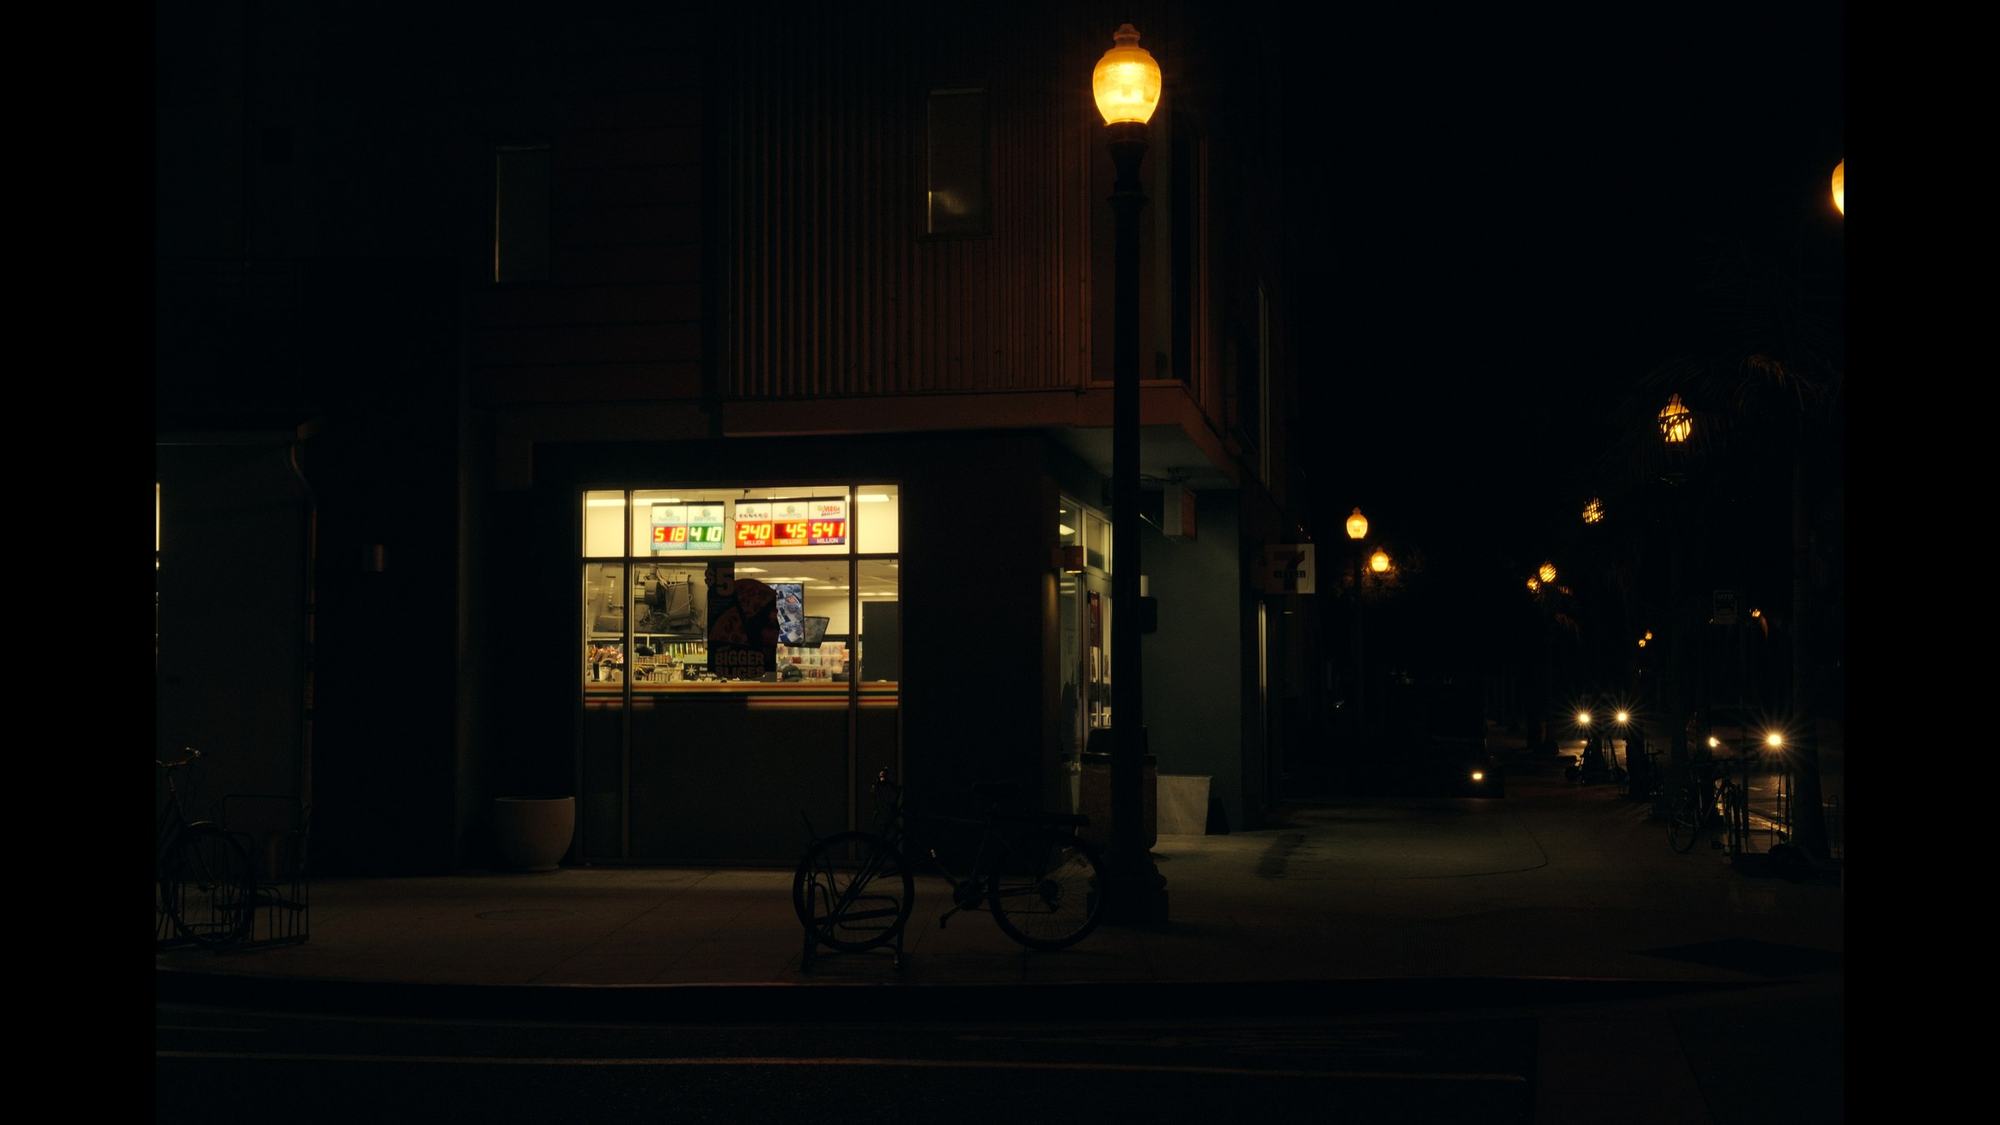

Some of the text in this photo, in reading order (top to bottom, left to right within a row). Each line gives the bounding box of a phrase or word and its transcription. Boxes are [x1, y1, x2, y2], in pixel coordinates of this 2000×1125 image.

[655, 527, 686, 542] 518
[690, 526, 722, 541] 410
[738, 523, 771, 540] 240
[786, 523, 807, 538] 45
[812, 522, 845, 538] 541
[714, 649, 766, 665] BIGGER
